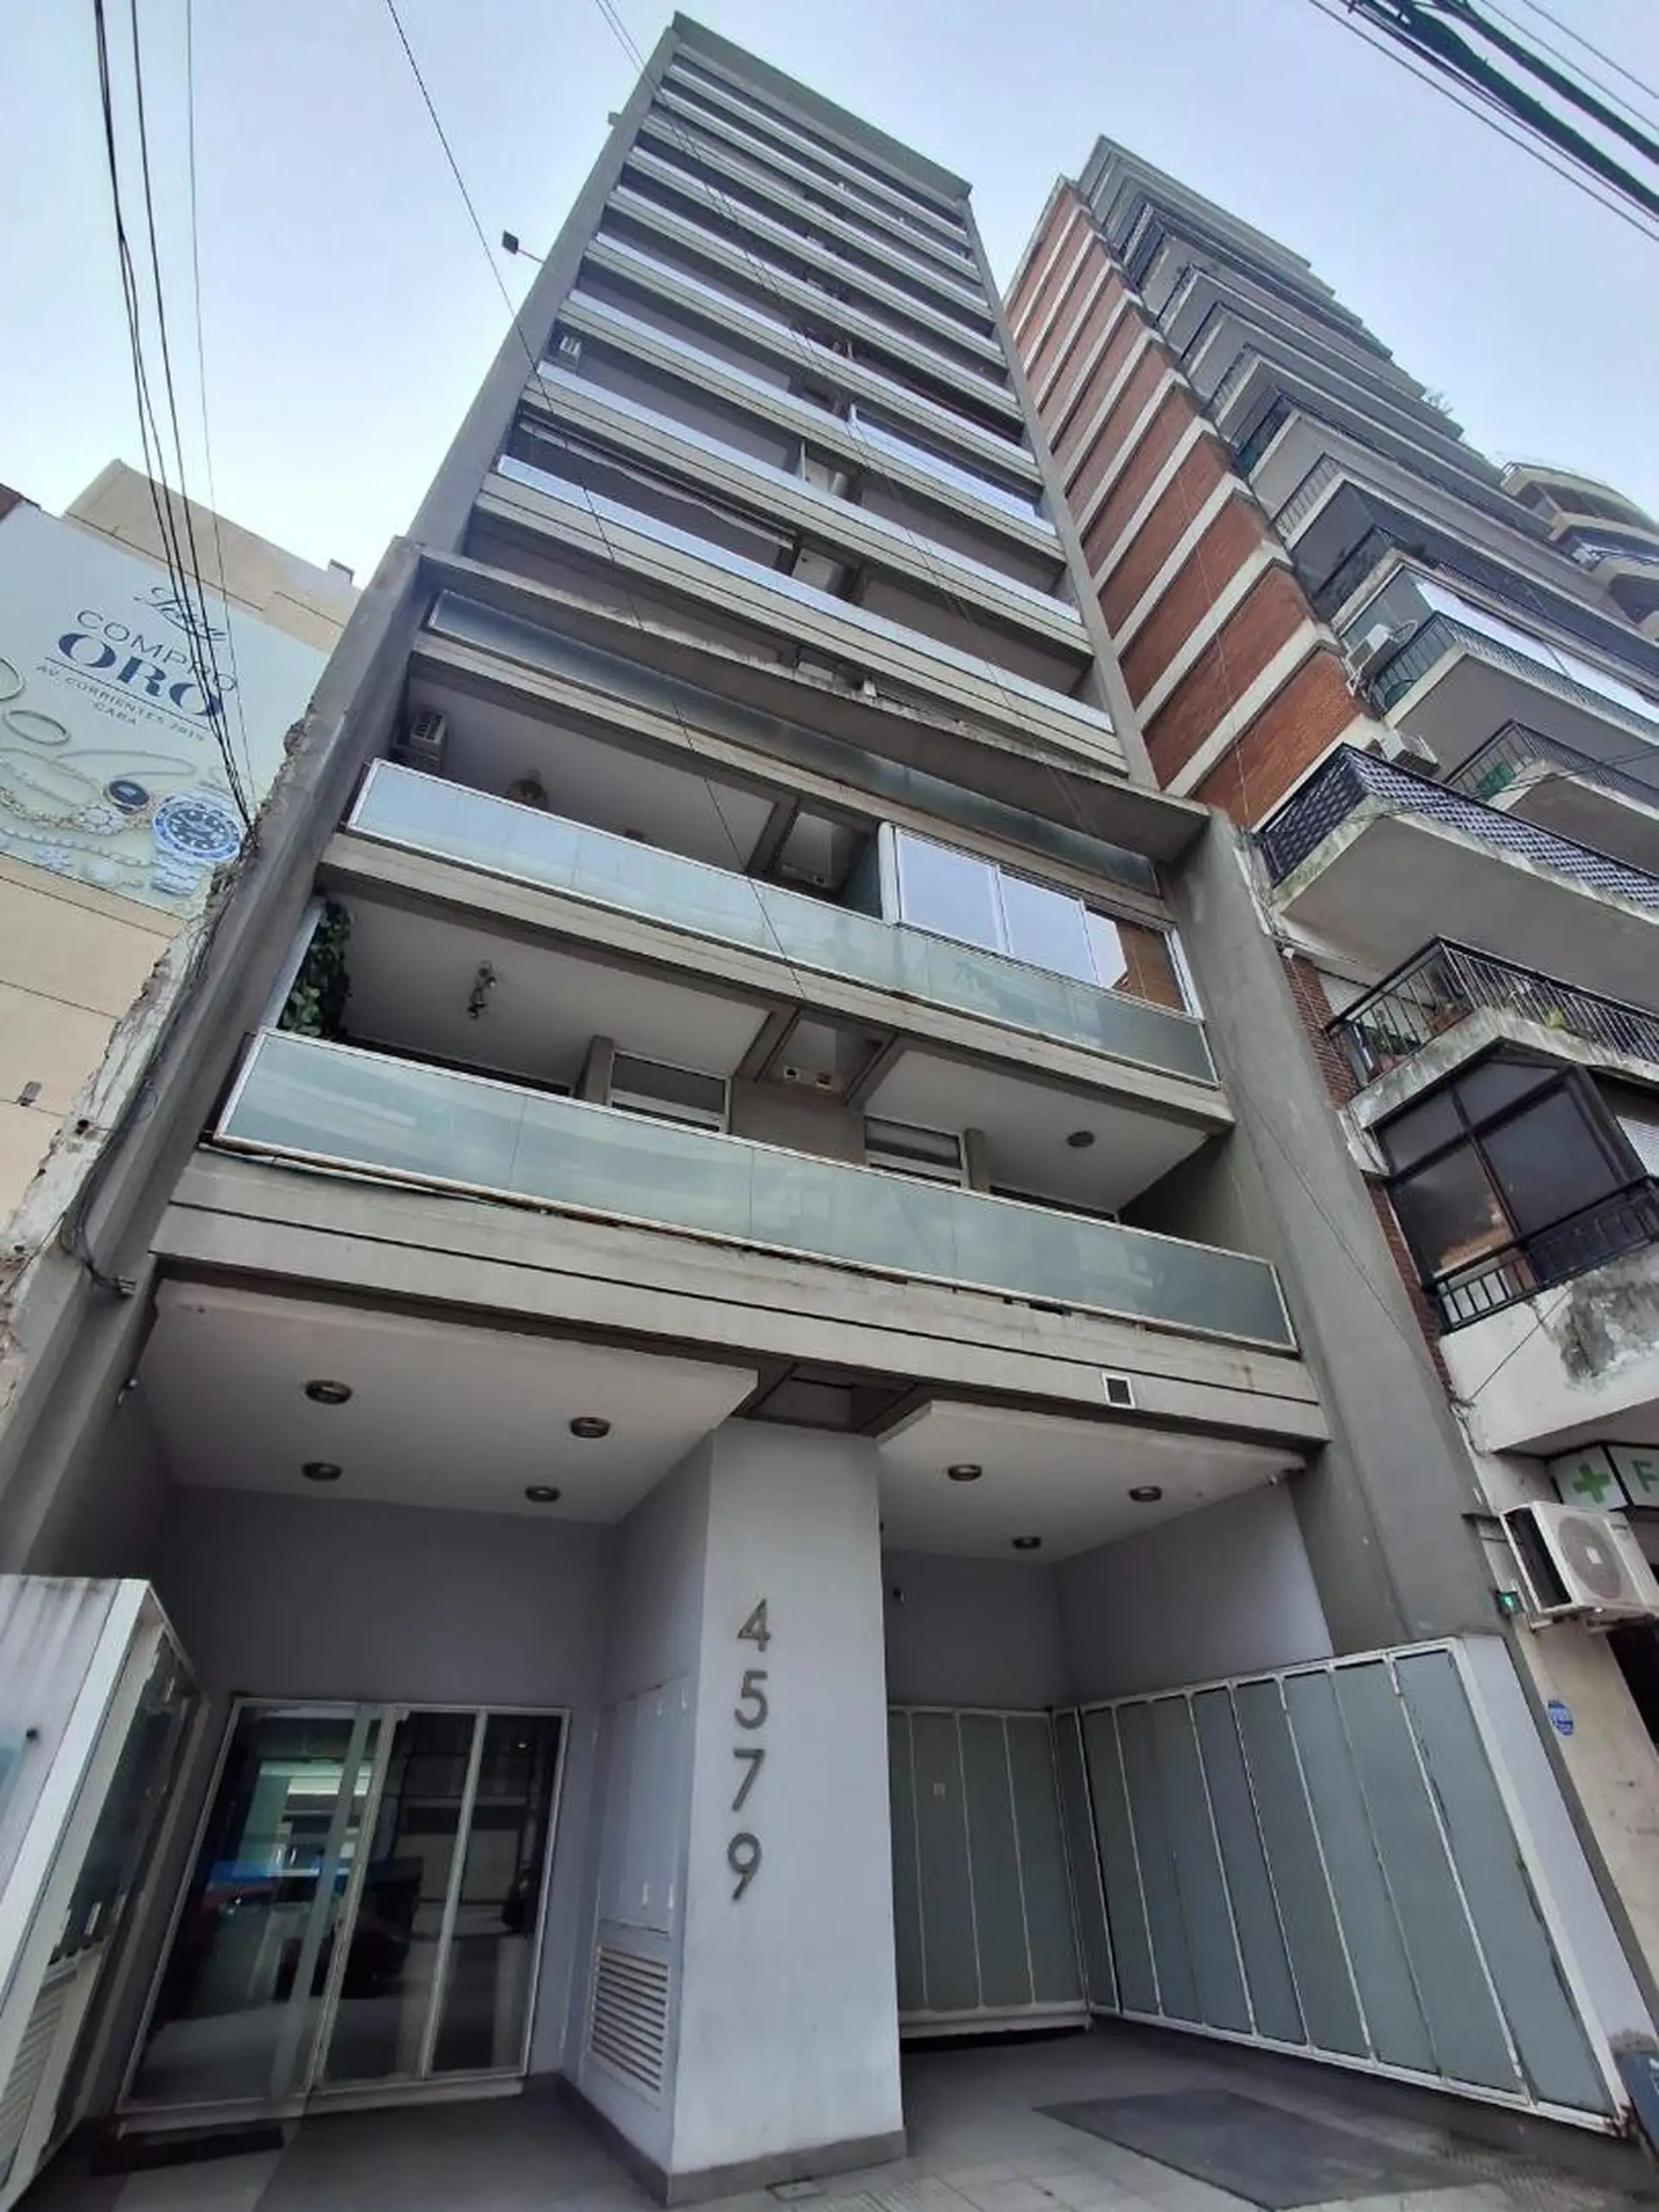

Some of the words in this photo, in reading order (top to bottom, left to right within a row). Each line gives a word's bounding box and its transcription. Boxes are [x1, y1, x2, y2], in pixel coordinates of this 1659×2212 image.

[58, 632, 222, 717] ORO
[77, 609, 238, 692] COMPRO
[727, 1598, 772, 1901] 4579
